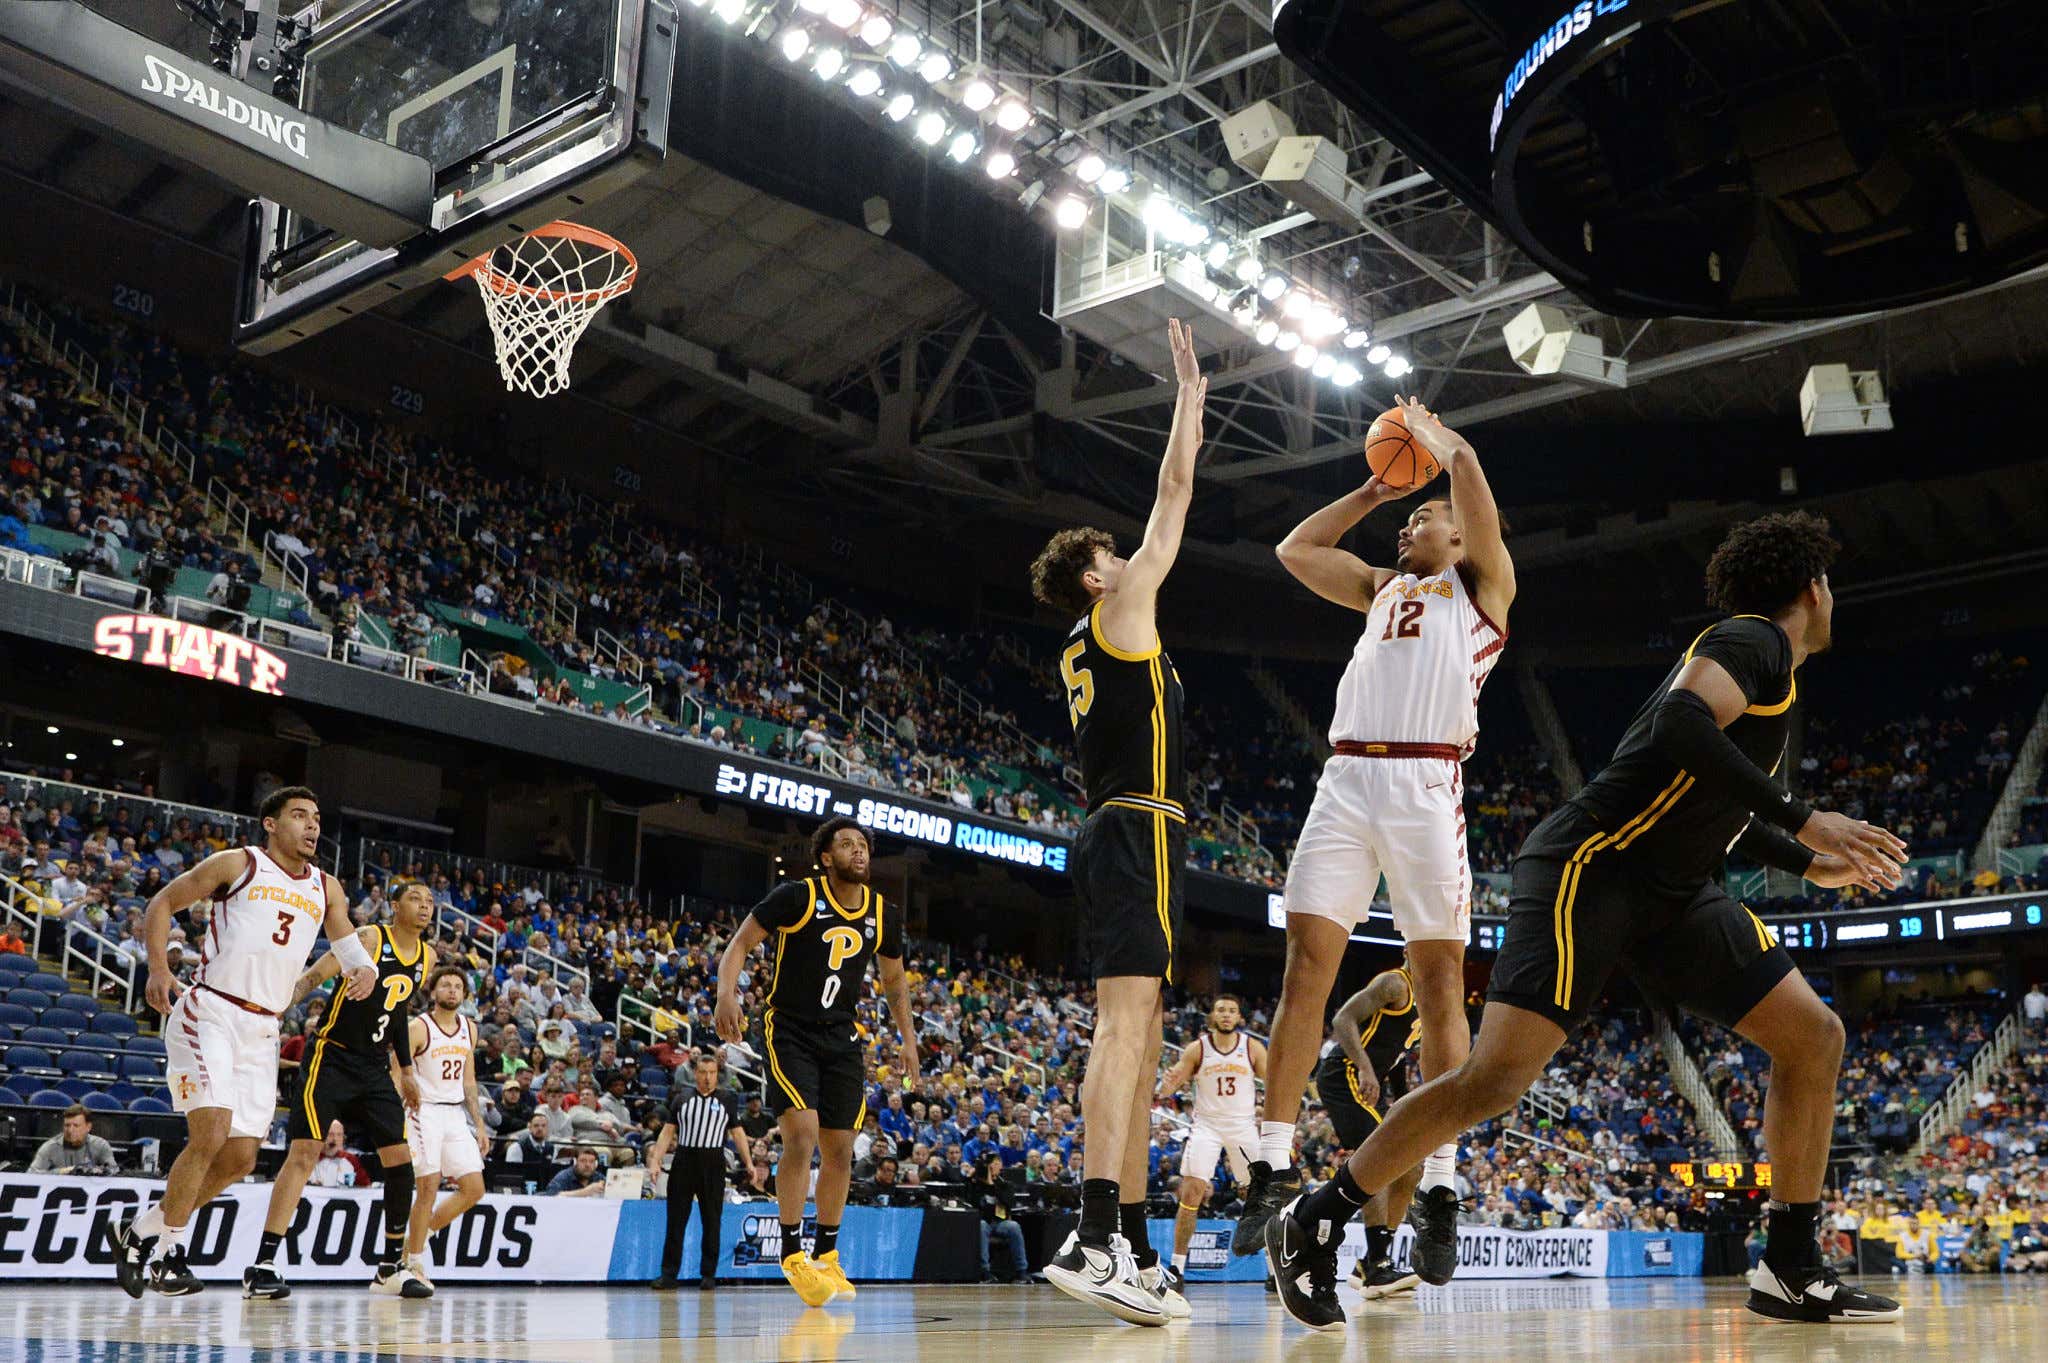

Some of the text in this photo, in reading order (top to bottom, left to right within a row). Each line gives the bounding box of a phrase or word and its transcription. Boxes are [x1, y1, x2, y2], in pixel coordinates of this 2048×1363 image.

[1504, 1, 1593, 109] ROUNDS
[141, 54, 307, 156] SPALDING
[1381, 600, 1424, 640] 12
[94, 614, 287, 696] STATE
[750, 772, 831, 815] FIRST
[857, 799, 952, 845] SECOND
[955, 822, 1045, 867] ROUNDS
[272, 910, 295, 946] 3
[1900, 917, 1922, 937] 19
[2026, 905, 2041, 925] 9
[822, 926, 863, 970] P
[382, 974, 414, 1011] P
[821, 975, 841, 1009] 0
[372, 1014, 390, 1042] 3
[442, 1059, 463, 1081] 22
[1217, 1076, 1236, 1097] 13
[0, 1184, 240, 1266] ECOD
[1505, 1235, 1593, 1268] CONFERENCE
